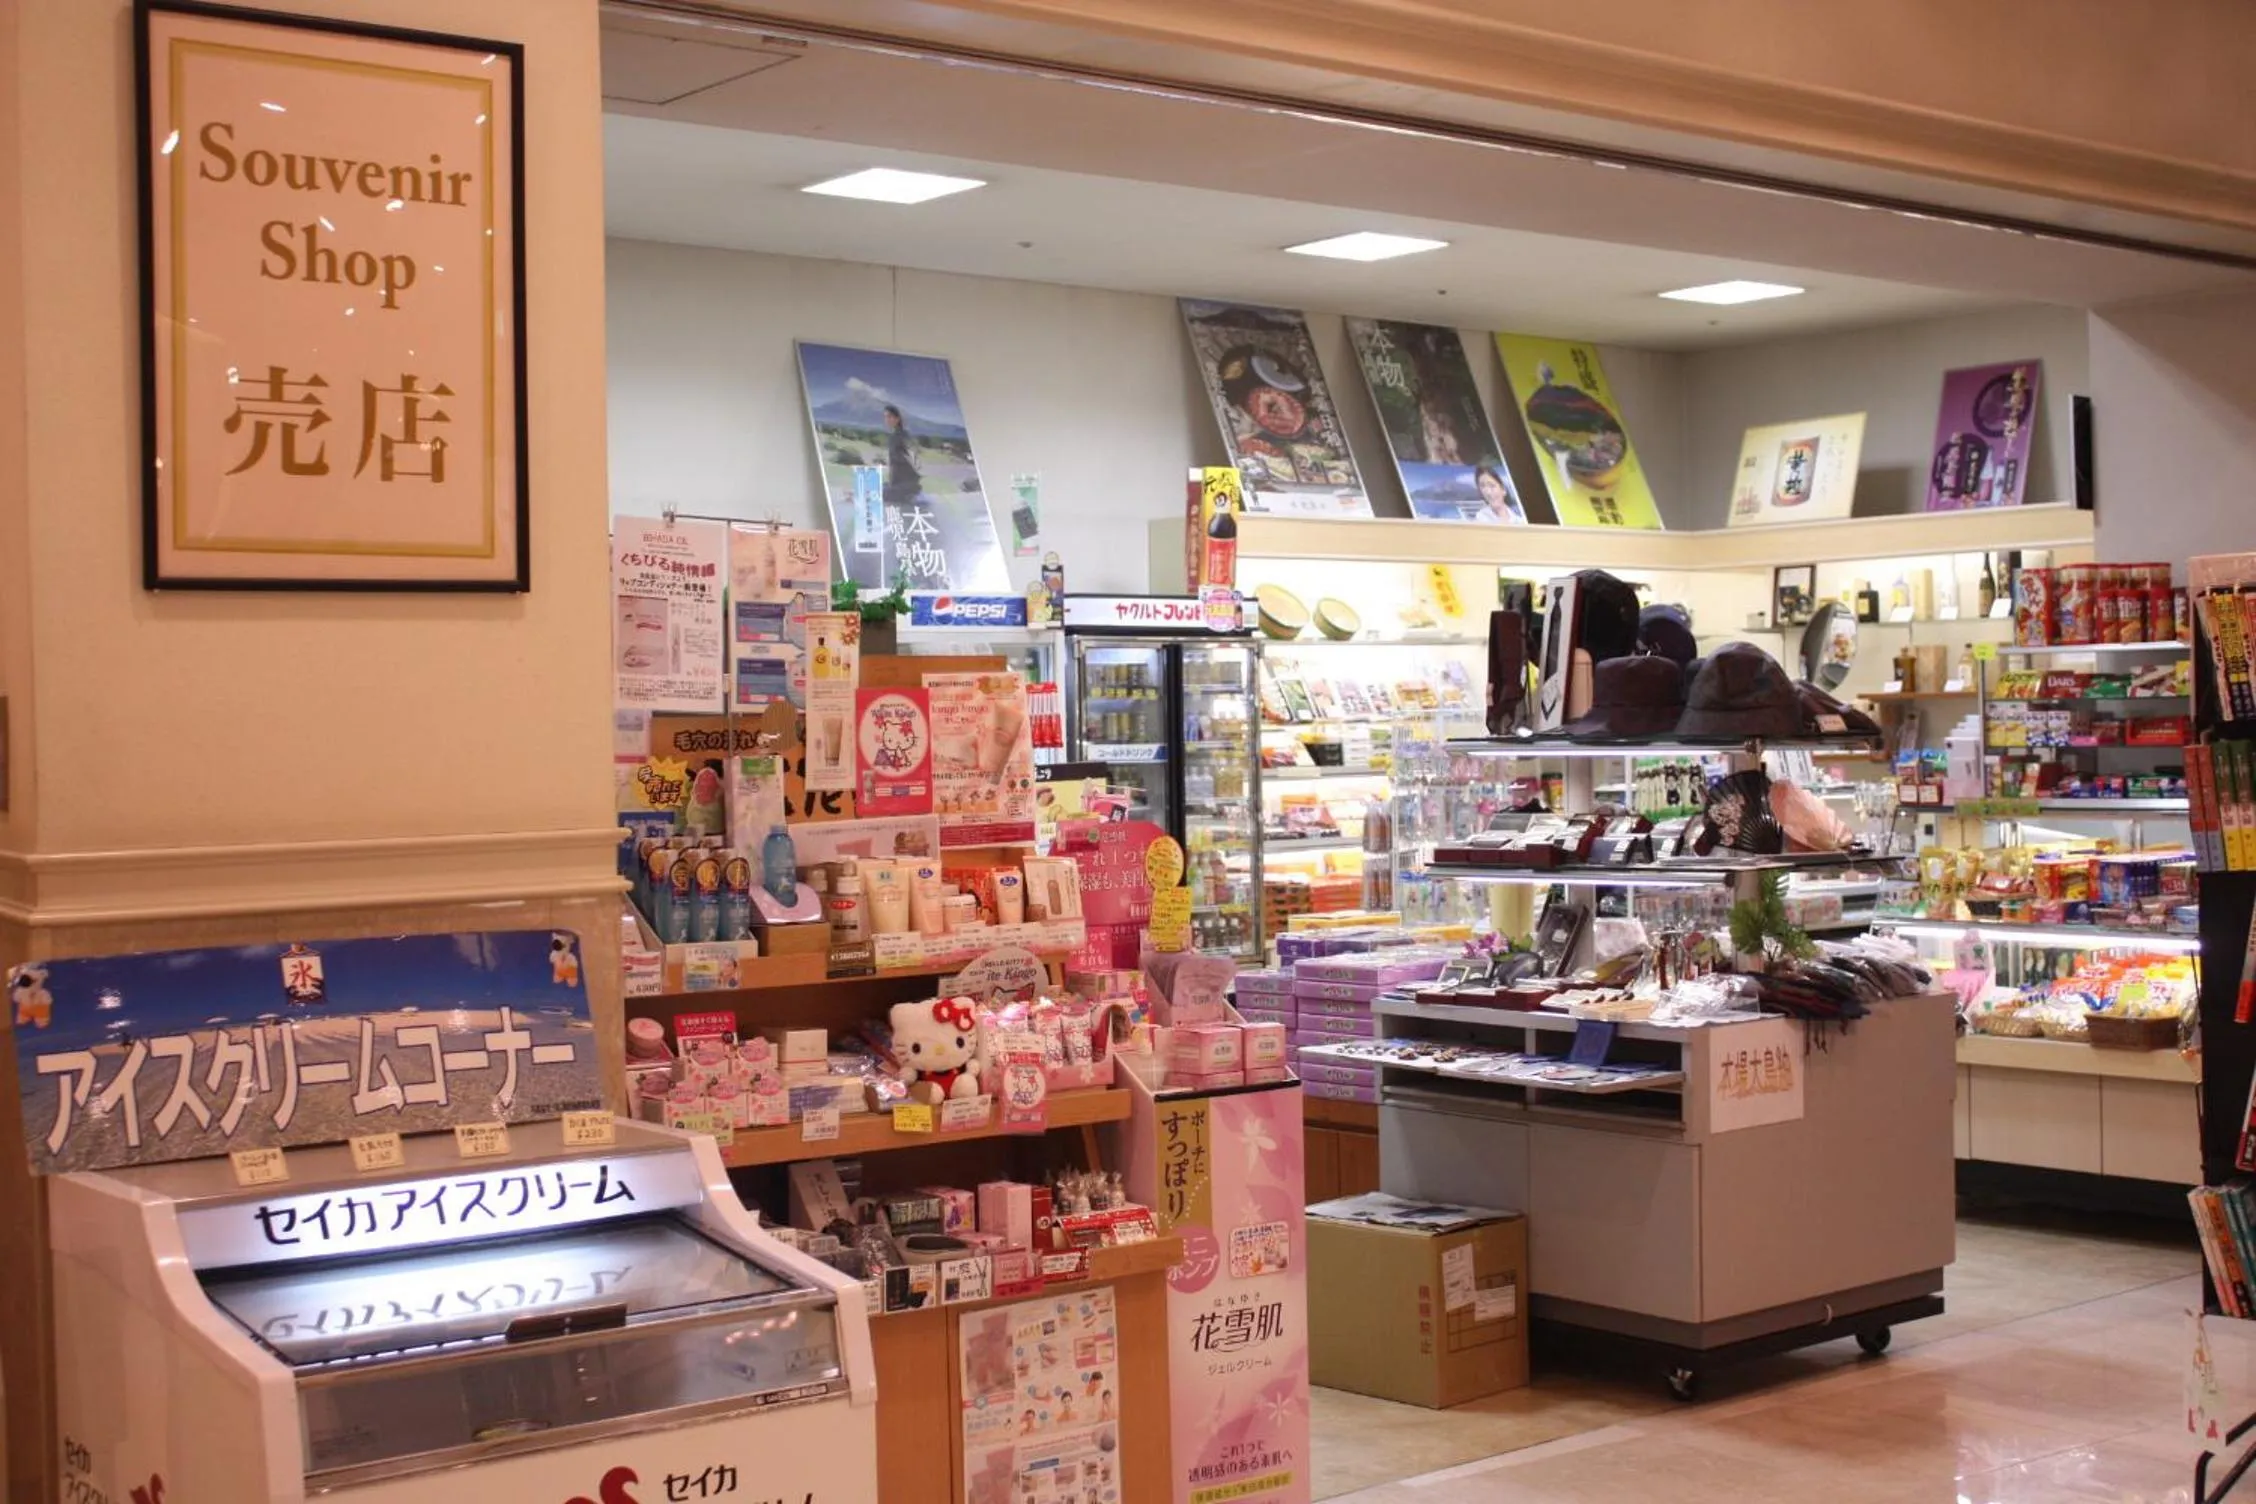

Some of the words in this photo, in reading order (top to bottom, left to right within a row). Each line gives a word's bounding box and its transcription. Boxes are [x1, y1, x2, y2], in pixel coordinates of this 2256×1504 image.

[199, 122, 472, 207] Souvenir
[260, 220, 416, 310] Shop
[223, 365, 455, 484] 売店
[952, 604, 1007, 620] PEPSI
[289, 959, 316, 989] 氷
[36, 1006, 576, 1155] アイスクリームコーナー
[1161, 1111, 1189, 1220] すっぽり
[1191, 1110, 1206, 1174] ポーチに
[254, 1165, 636, 1245] セイカアイスクリーム
[1191, 1302, 1284, 1352] 花雪肌
[662, 1464, 738, 1502] セイカ
